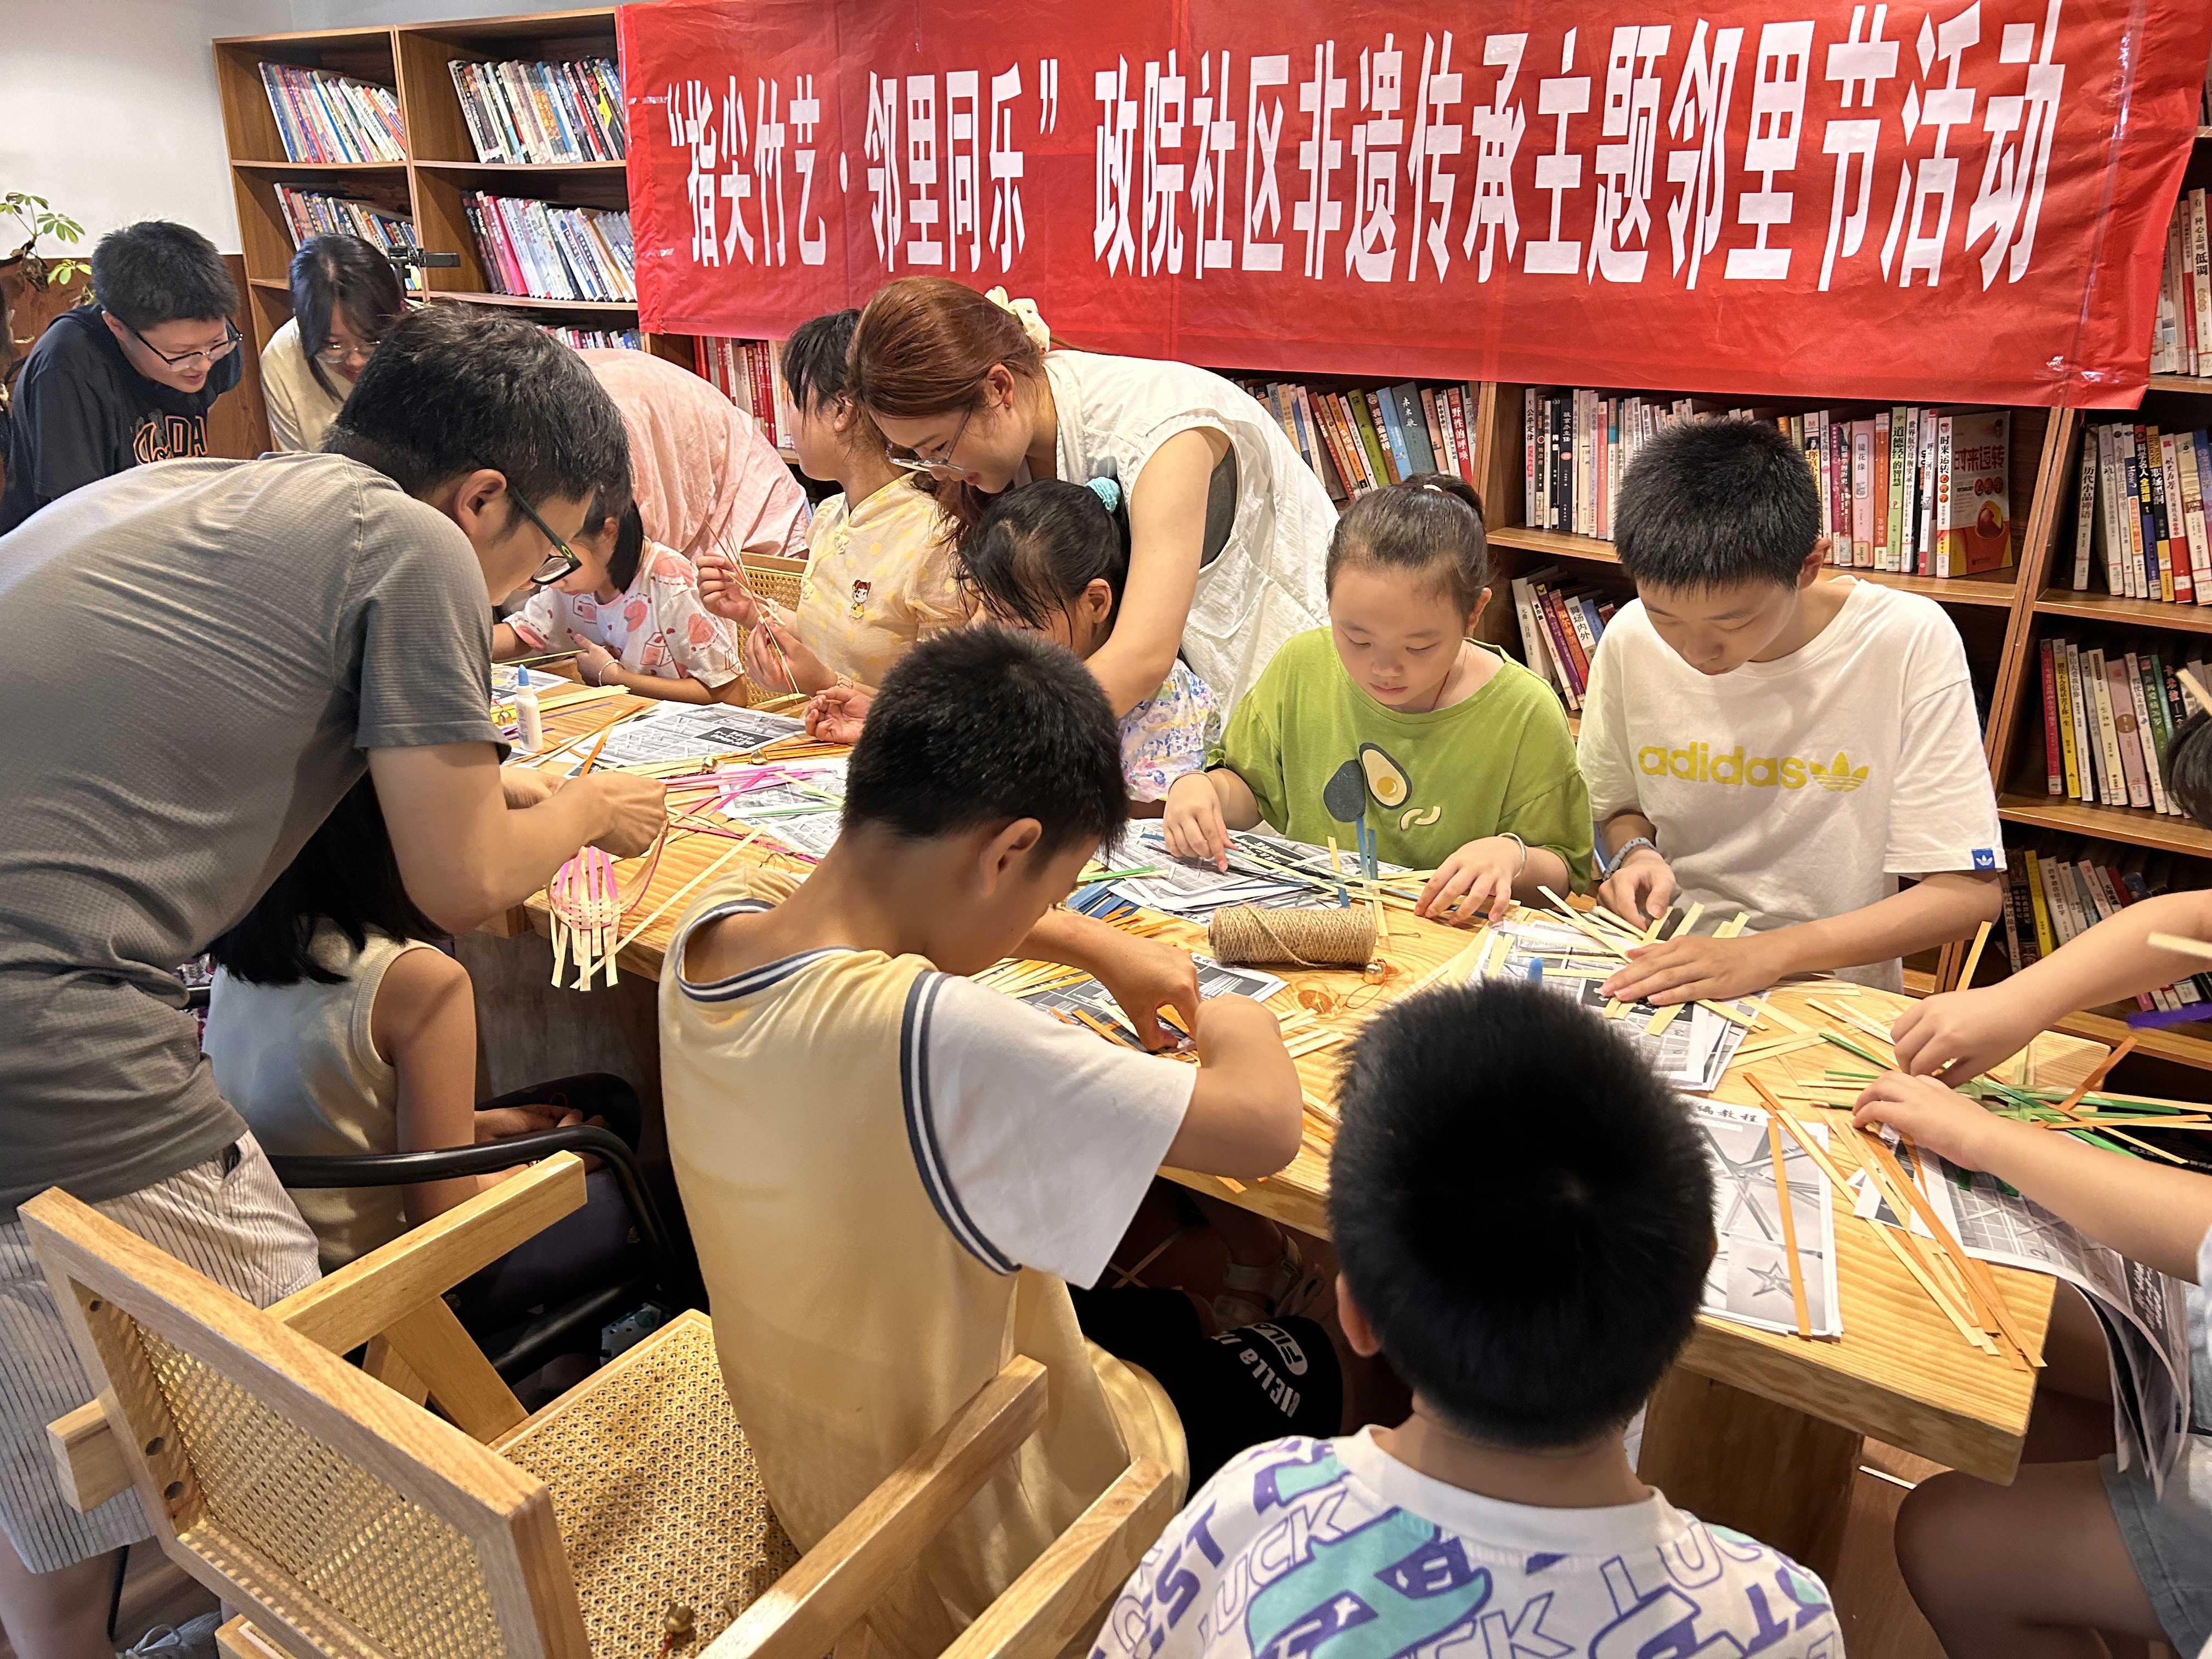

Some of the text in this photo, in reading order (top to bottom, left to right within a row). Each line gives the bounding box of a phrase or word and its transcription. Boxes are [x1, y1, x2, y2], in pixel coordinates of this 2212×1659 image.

[667, 0, 2066, 292] “指尖竹艺·邻里同乐” 政院社区非遗传承主题邻里节活动
[1452, 407, 1469, 460] 野性的呼唤
[1858, 443, 1866, 471] 镜花缘
[1892, 426, 1904, 487] 道德经的智慧
[1940, 435, 1949, 474] 时来运转
[1954, 445, 2005, 472] 时来运转
[2128, 466, 2137, 488] How?
[1570, 605, 1590, 641] 舞场内外
[1638, 741, 1806, 789] adidas
